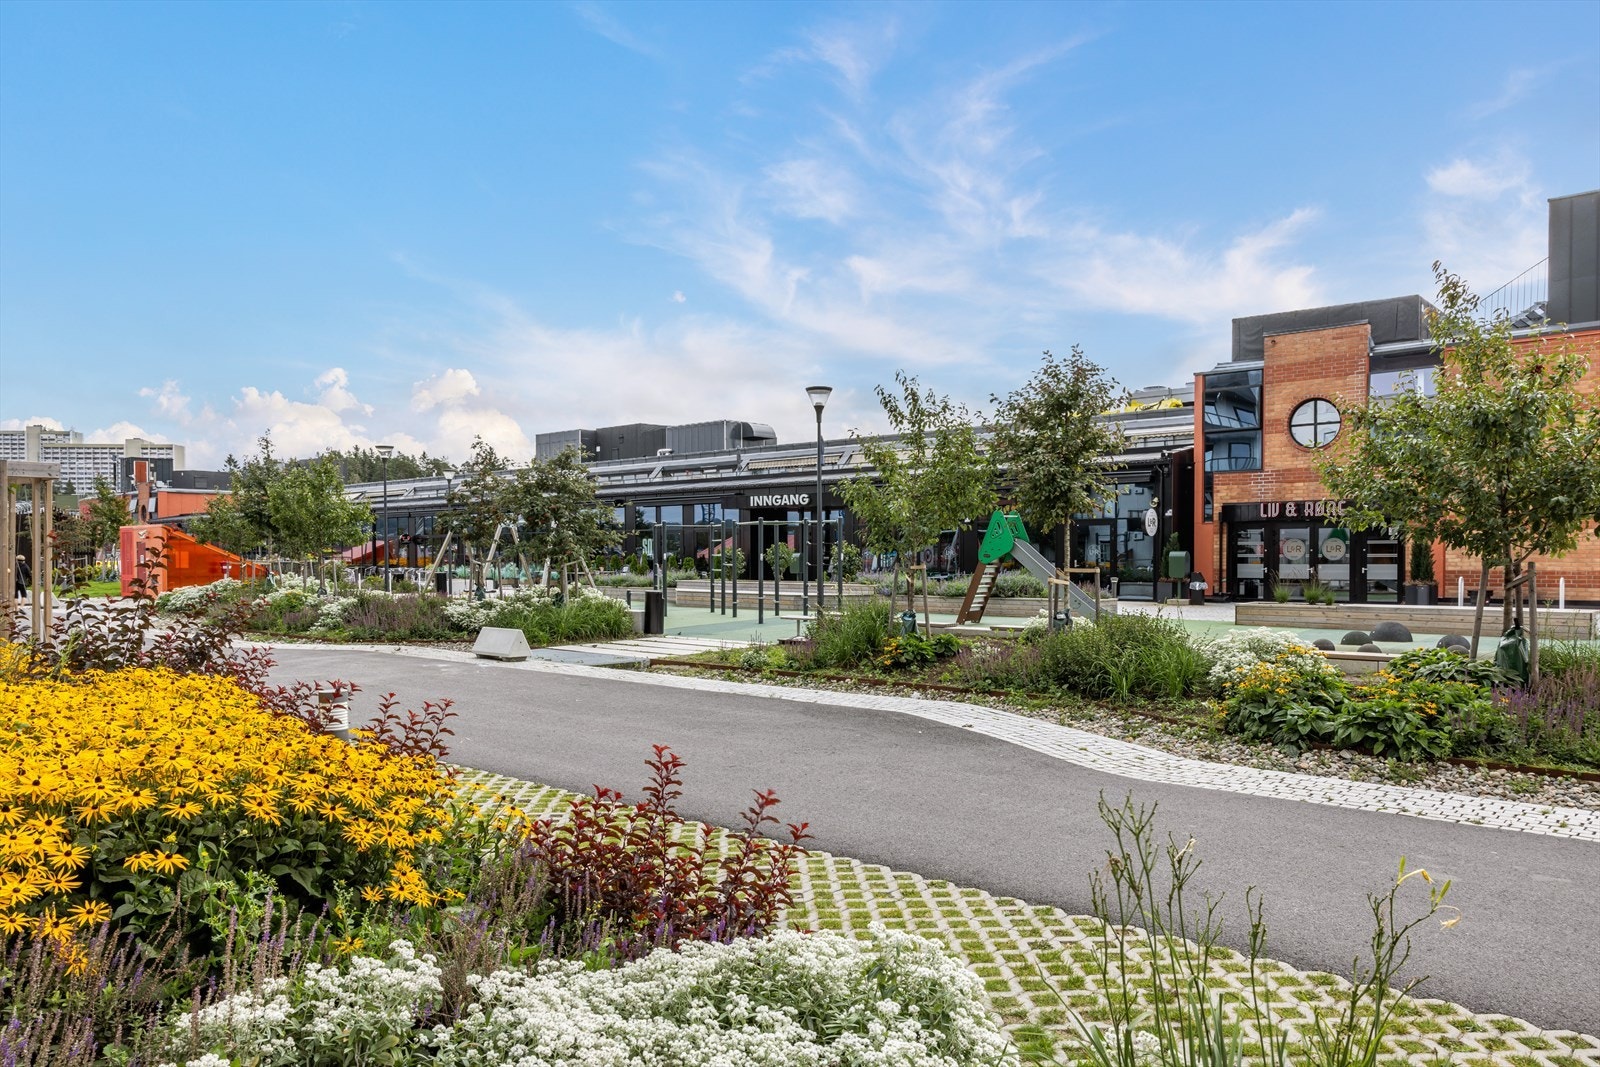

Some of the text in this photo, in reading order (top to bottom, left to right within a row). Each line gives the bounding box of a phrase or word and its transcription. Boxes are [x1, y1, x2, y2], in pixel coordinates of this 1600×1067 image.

[750, 494, 810, 507] INNGANG
[1260, 502, 1280, 518] LIV
[1285, 501, 1298, 517] &
